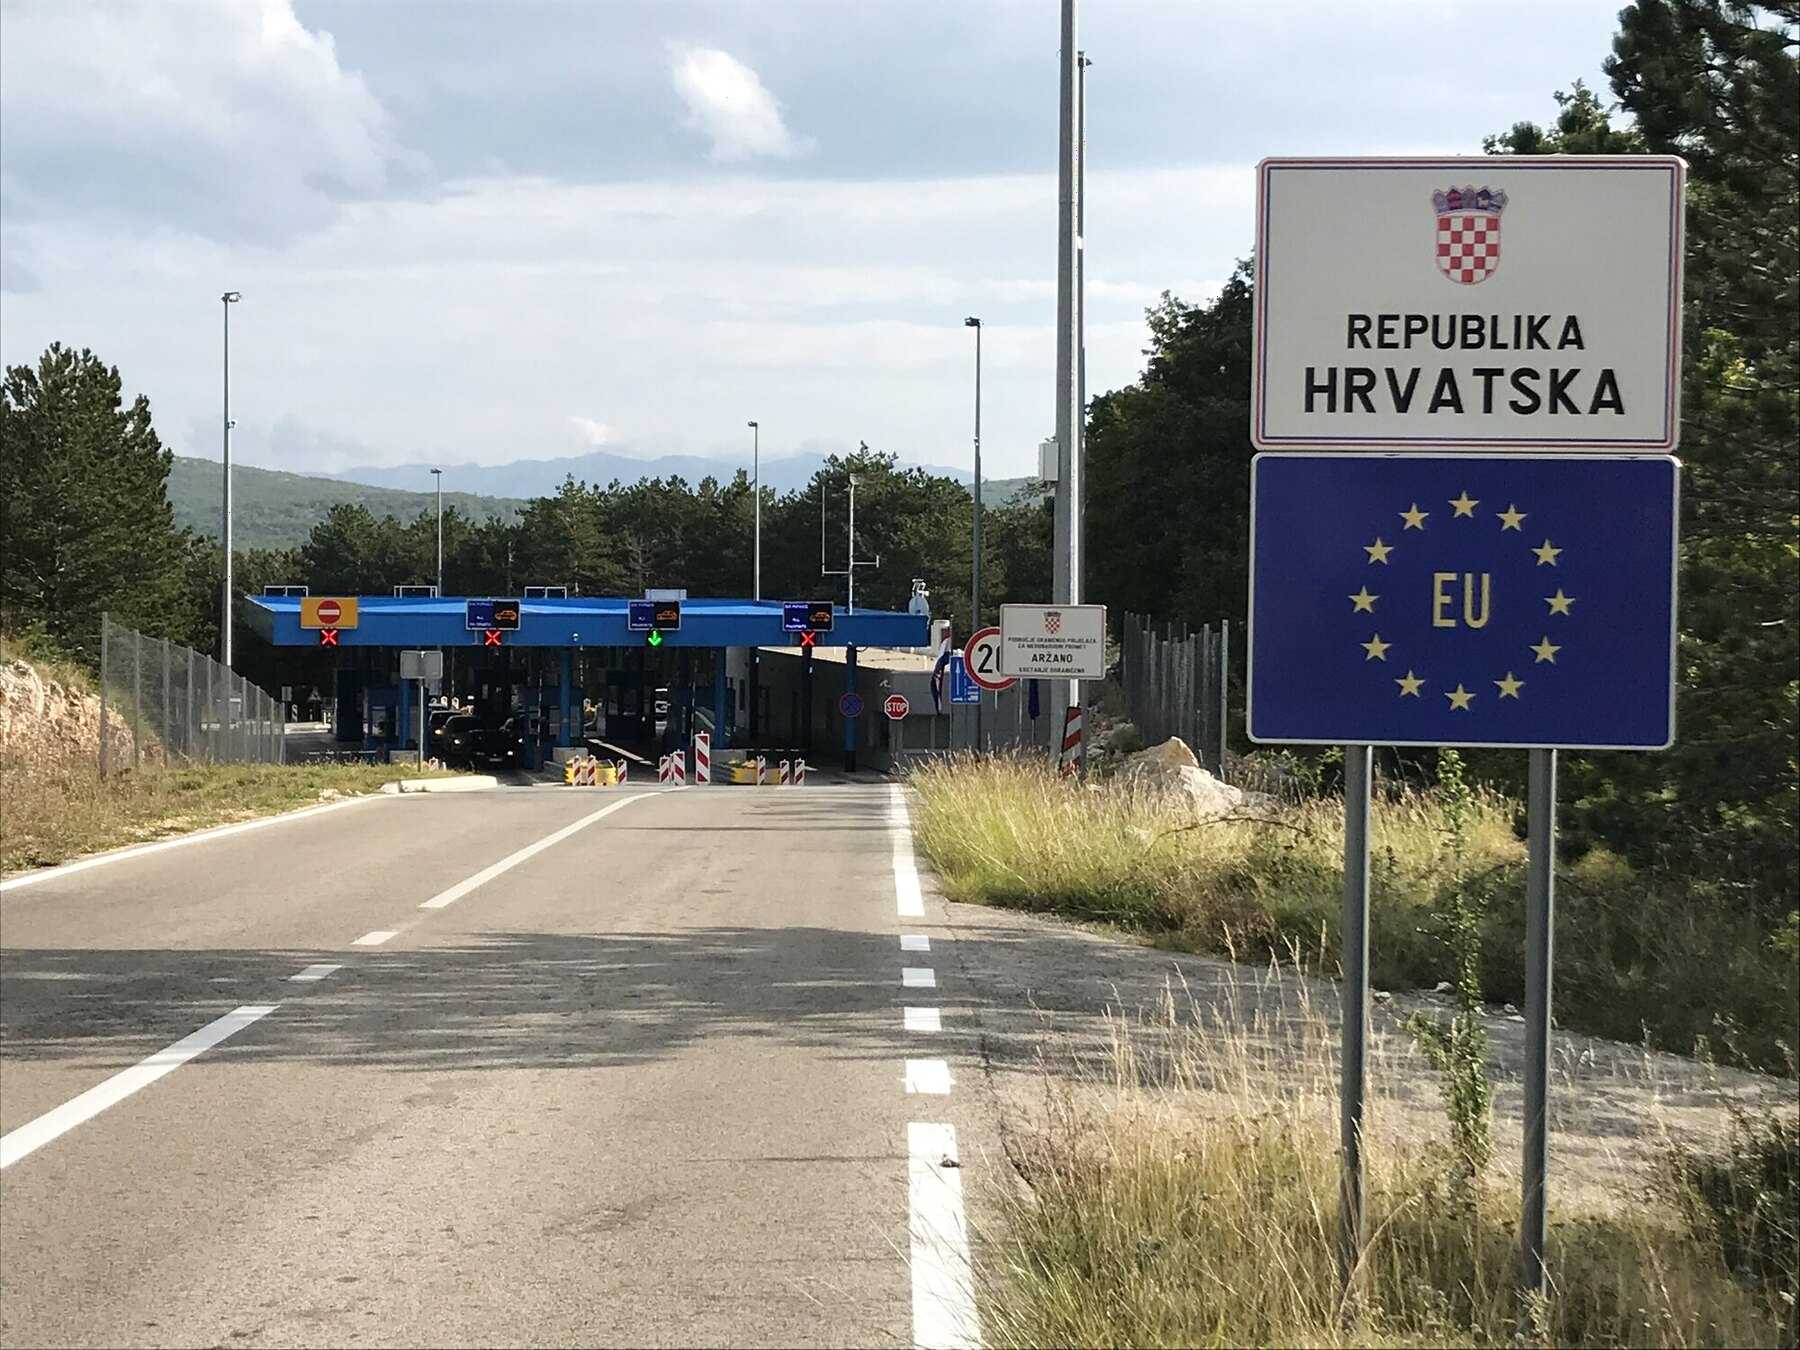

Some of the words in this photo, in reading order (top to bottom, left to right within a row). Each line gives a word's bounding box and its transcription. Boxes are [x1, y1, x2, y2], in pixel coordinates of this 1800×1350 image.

[1347, 313, 1585, 351] REPUBLIKA
[1304, 366, 1626, 416] HRVATSKA
[1433, 572, 1490, 629] EU
[978, 643, 1000, 673] 2
[1031, 651, 1073, 663] ARŽANO
[886, 702, 907, 713] STOP
